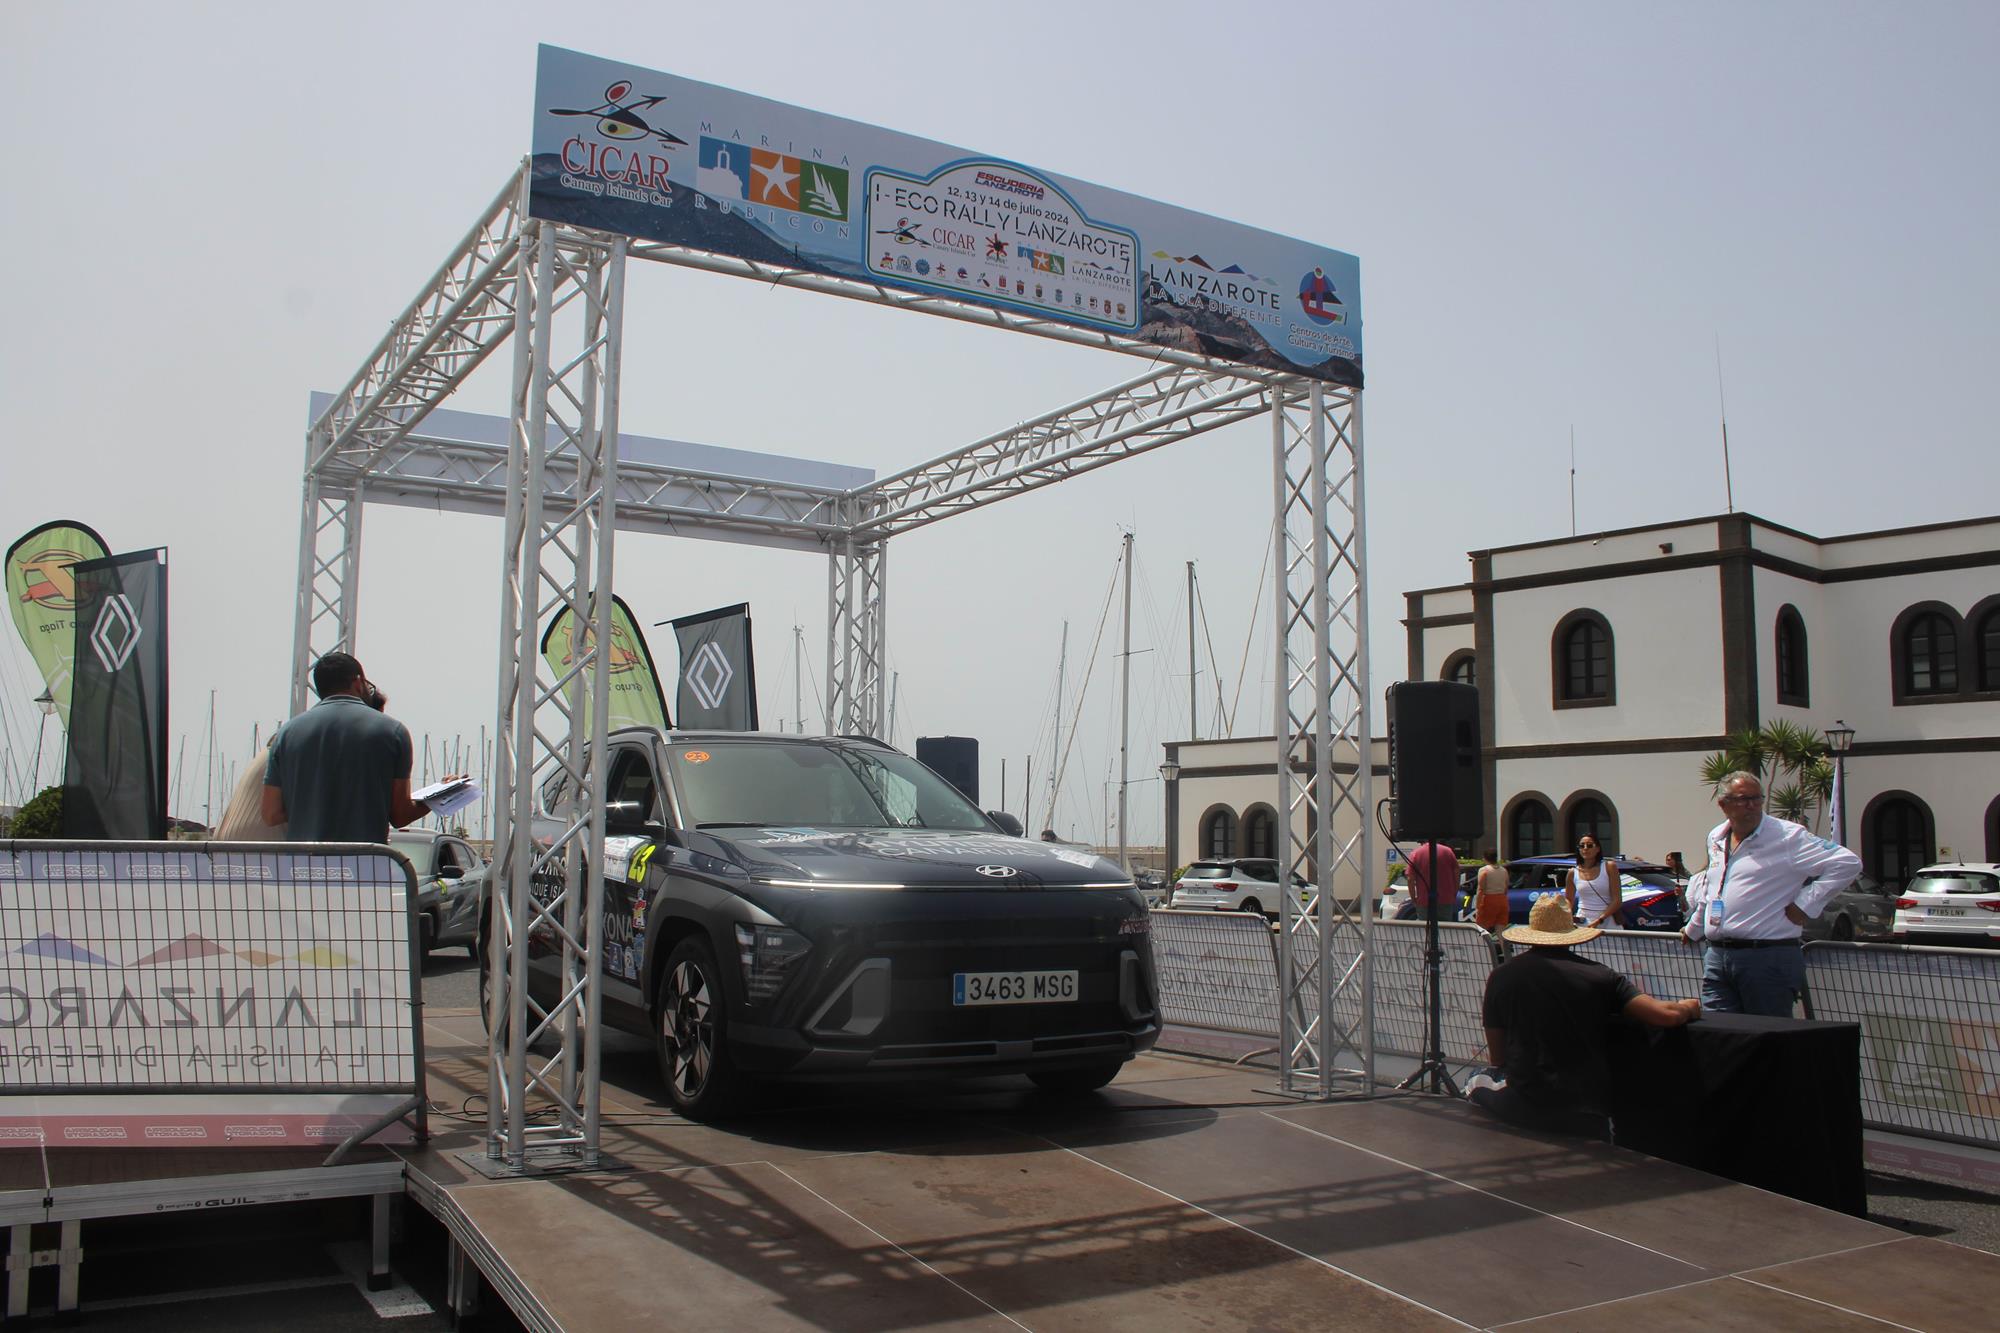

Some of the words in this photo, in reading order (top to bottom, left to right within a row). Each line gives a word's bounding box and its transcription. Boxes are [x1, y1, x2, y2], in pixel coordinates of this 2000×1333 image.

[700, 120, 850, 166] MARINA
[561, 137, 672, 193] CICAR
[561, 173, 604, 196] Canary
[606, 183, 648, 204] Islands
[650, 191, 673, 208] Car
[974, 178, 1044, 200] LANZAROTE
[976, 171, 1045, 195] ESCUDERIA
[965, 190, 978, 203] 13
[979, 194, 986, 206] y
[988, 196, 1001, 208] 14
[1003, 198, 1017, 211] de
[1018, 201, 1042, 217] julio
[1044, 209, 1069, 225] 2024
[932, 227, 975, 251] CICAR
[943, 199, 1010, 231] RALLY
[1015, 215, 1130, 262] LANZAROTE
[1071, 266, 1131, 287] LANZAROTE
[1150, 263, 1281, 310] LANZAROTE
[1150, 284, 1167, 300] LA
[1173, 292, 1204, 310] ISLA
[1208, 299, 1282, 327] DIFERENTE
[1289, 322, 1321, 340] Centros
[1322, 332, 1332, 343] de
[1287, 333, 1317, 350] Cultura
[1324, 342, 1355, 359] Turismo
[877, 847, 1047, 857] CANARIAS
[969, 976, 1026, 1001] 3463
[1033, 974, 1073, 998] MSG
[204, 1196, 256, 1208] GUIL
